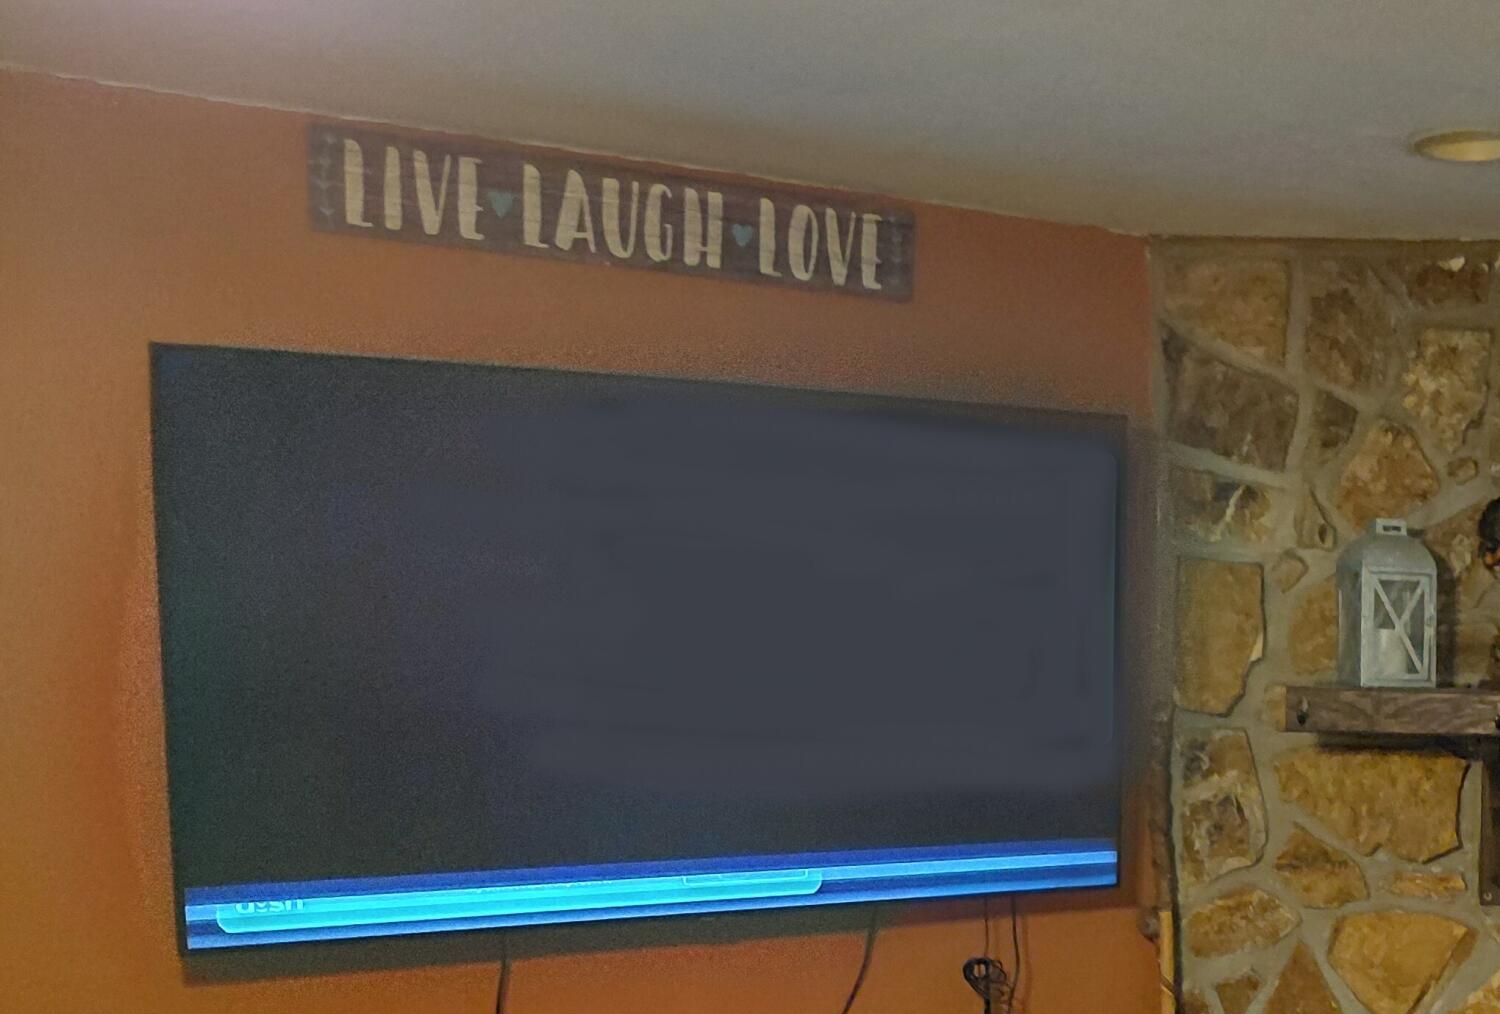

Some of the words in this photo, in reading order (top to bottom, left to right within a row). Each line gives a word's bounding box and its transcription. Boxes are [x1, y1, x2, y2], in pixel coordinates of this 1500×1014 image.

[343, 138, 485, 241] LIVE
[522, 162, 725, 269] LAUGH
[757, 197, 884, 291] LOVE
